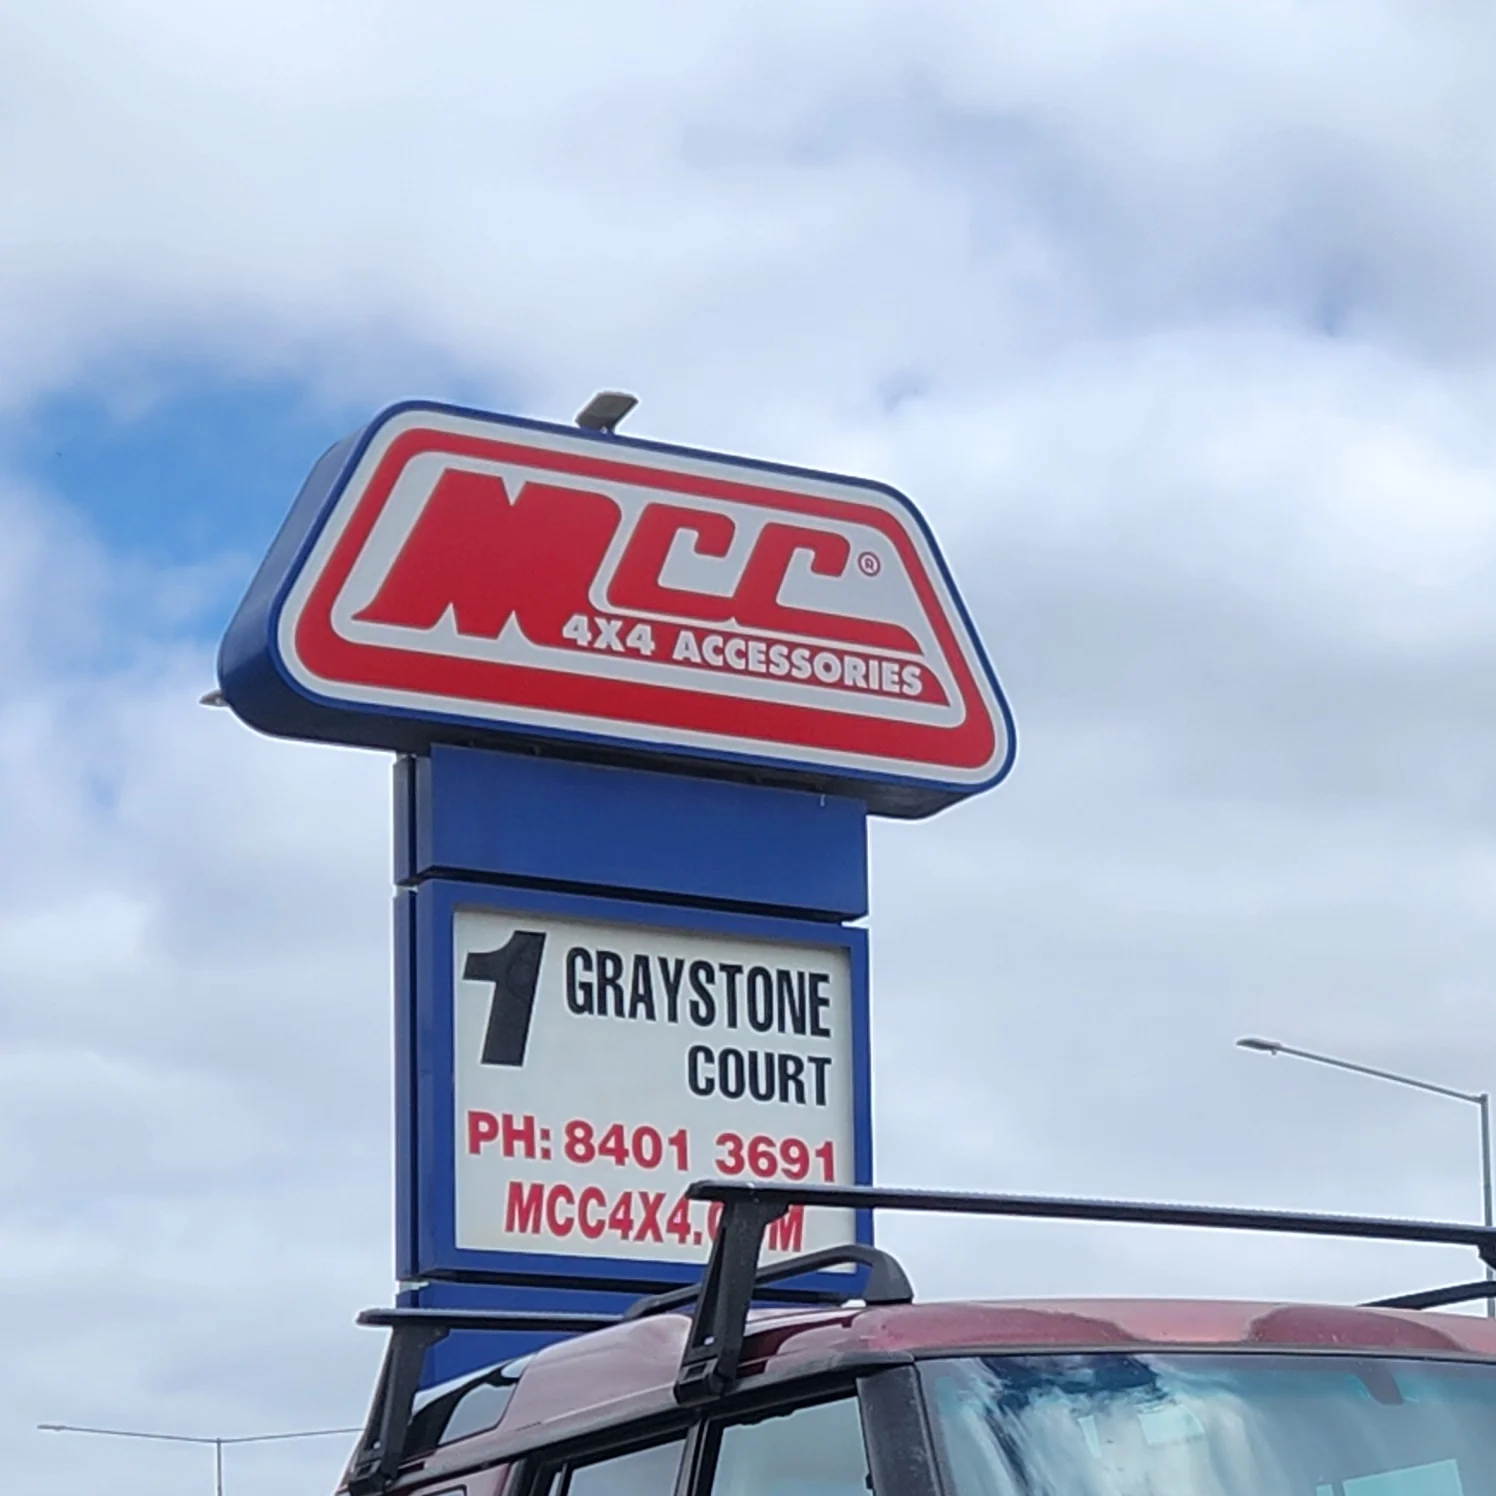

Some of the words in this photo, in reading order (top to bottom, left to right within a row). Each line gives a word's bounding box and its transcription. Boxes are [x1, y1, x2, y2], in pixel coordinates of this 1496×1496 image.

[350, 467, 926, 658] MCC
[562, 614, 656, 657] 4X4
[672, 630, 924, 698] ACCESSORIES
[463, 930, 547, 1067] 1
[565, 946, 832, 1038] GRAYSTONE
[688, 1045, 832, 1106] COURT
[467, 1110, 552, 1161] PH:
[564, 1120, 690, 1172] 8401
[715, 1132, 836, 1183] 3691
